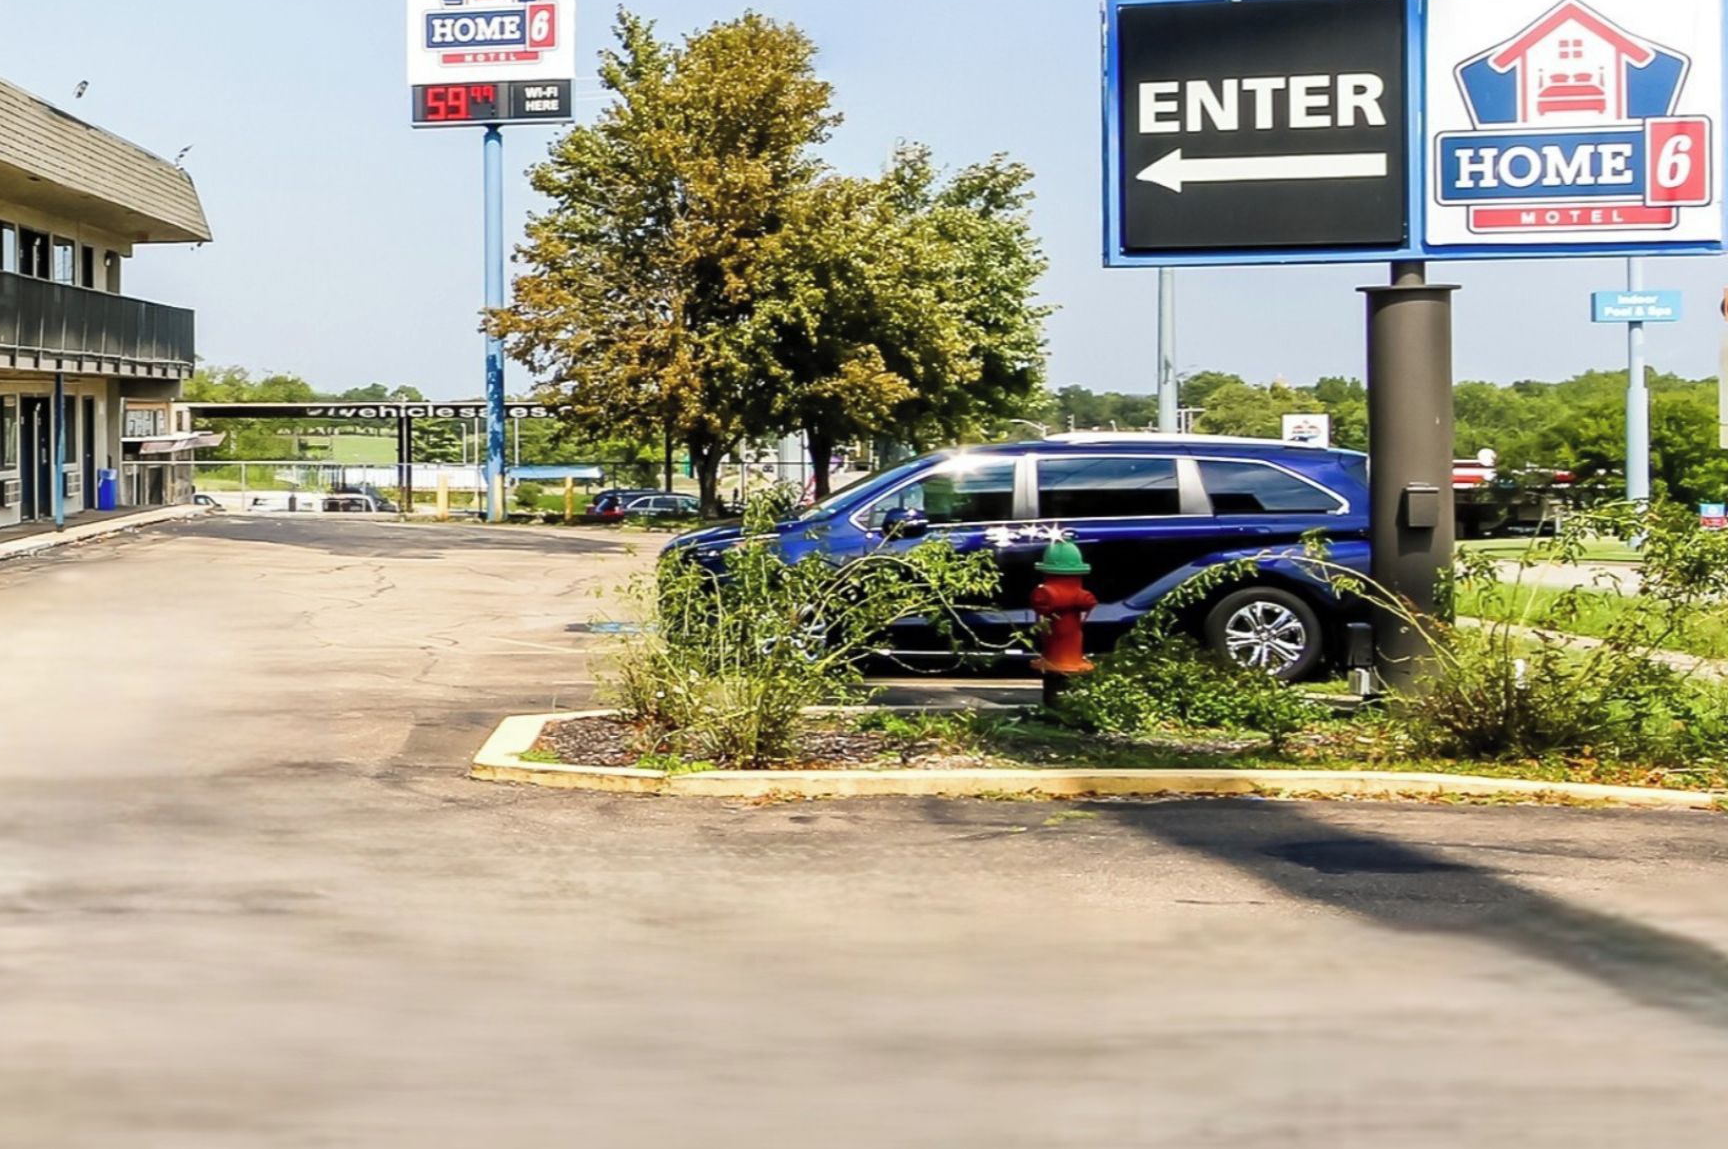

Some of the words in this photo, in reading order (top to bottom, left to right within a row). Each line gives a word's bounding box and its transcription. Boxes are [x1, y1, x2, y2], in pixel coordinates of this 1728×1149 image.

[432, 16, 521, 43] HOME
[531, 10, 550, 42] 6
[464, 53, 517, 62] MOTEL
[524, 86, 558, 98] WI-FI
[524, 99, 560, 112] HERE
[1138, 73, 1385, 134] ENTER
[1454, 144, 1633, 188] HOME
[1656, 134, 1692, 188] 6
[1520, 208, 1624, 225] MOTEL
